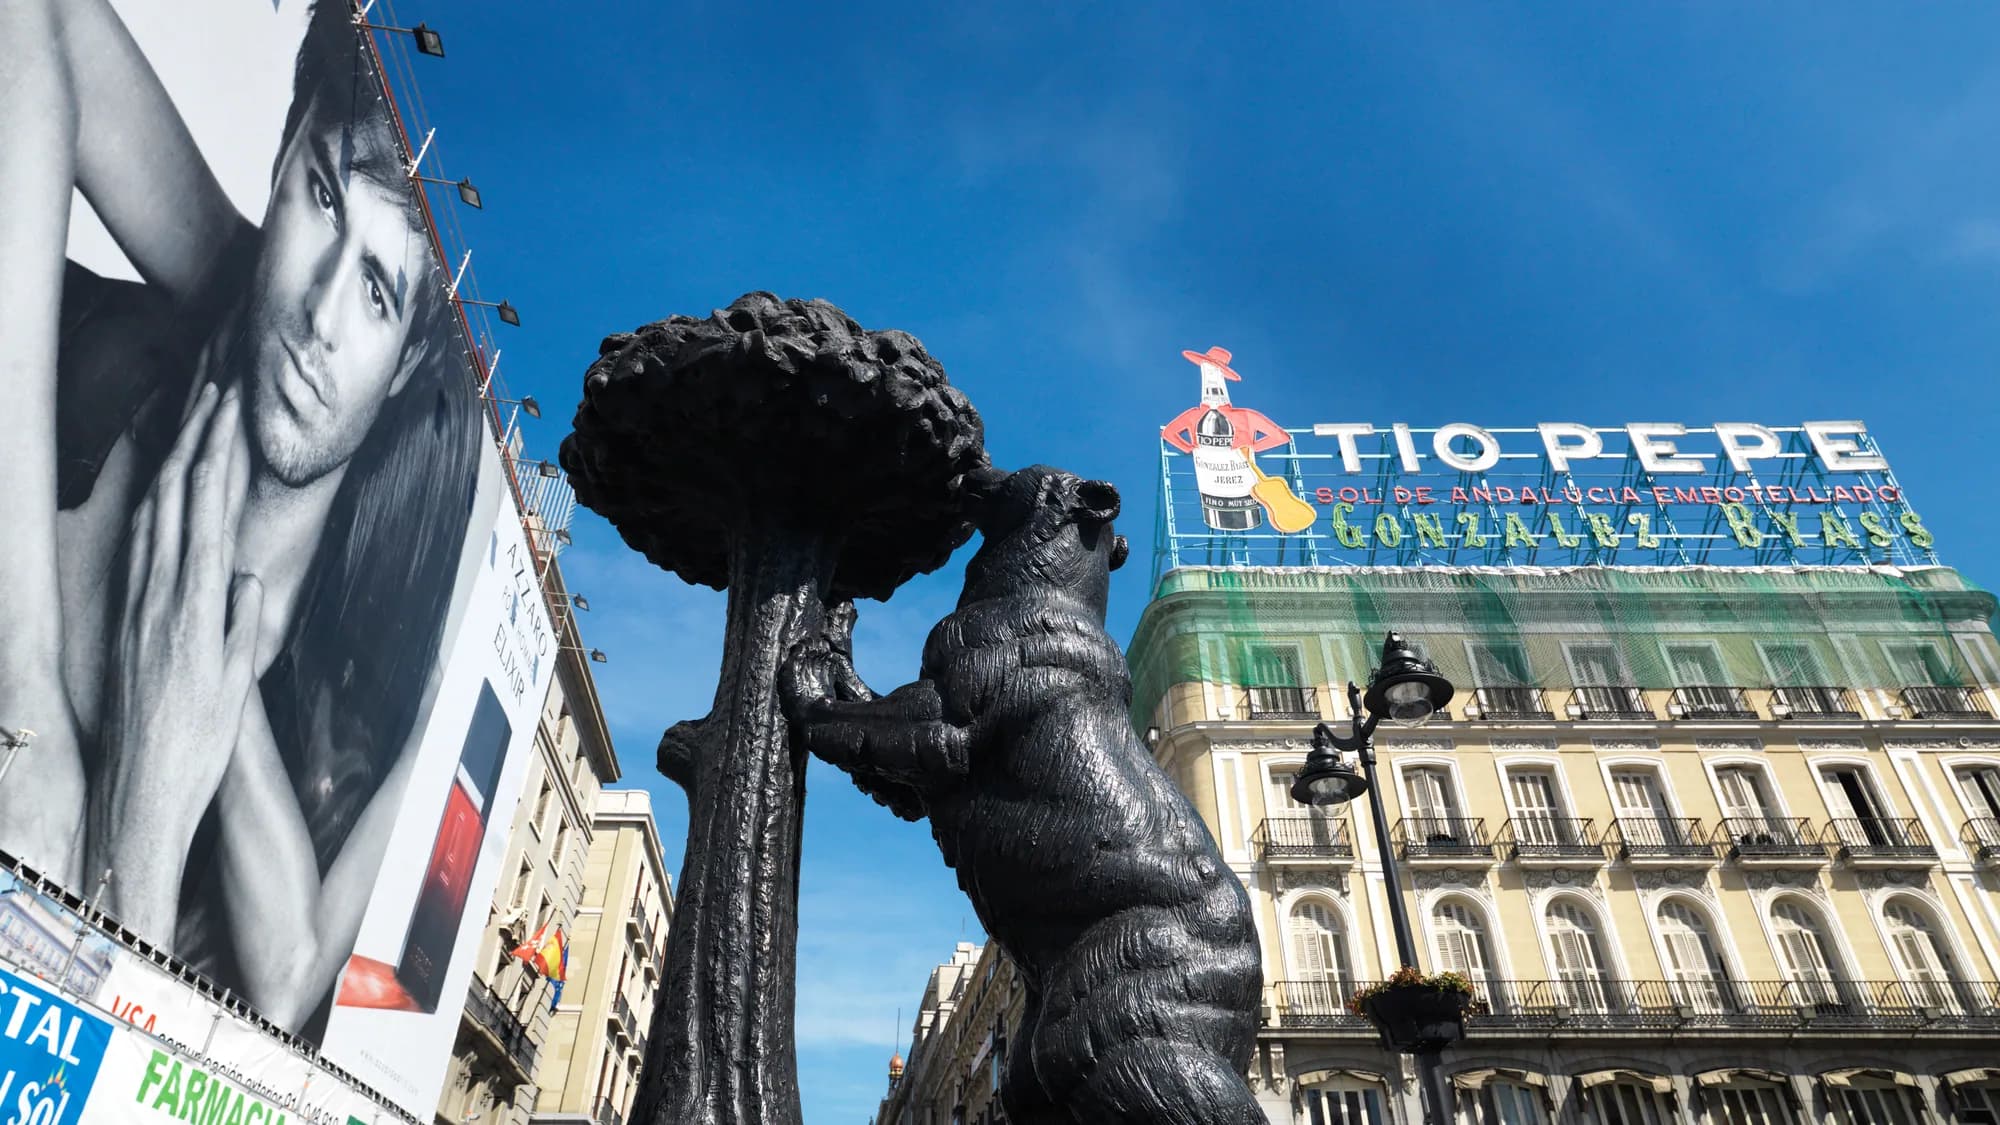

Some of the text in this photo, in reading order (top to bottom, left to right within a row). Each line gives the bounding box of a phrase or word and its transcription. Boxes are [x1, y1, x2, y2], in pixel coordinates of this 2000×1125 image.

[1313, 419, 1890, 473] TIO PEPE
[1214, 475, 1243, 485] JEREZ
[1315, 485, 1901, 505] SOL DE ANDALUCIA EMBOTELLADO
[1332, 502, 1935, 549] GONZALEZ BYASS
[506, 543, 548, 657] AZZARO
[493, 623, 526, 707] ELIXIR
